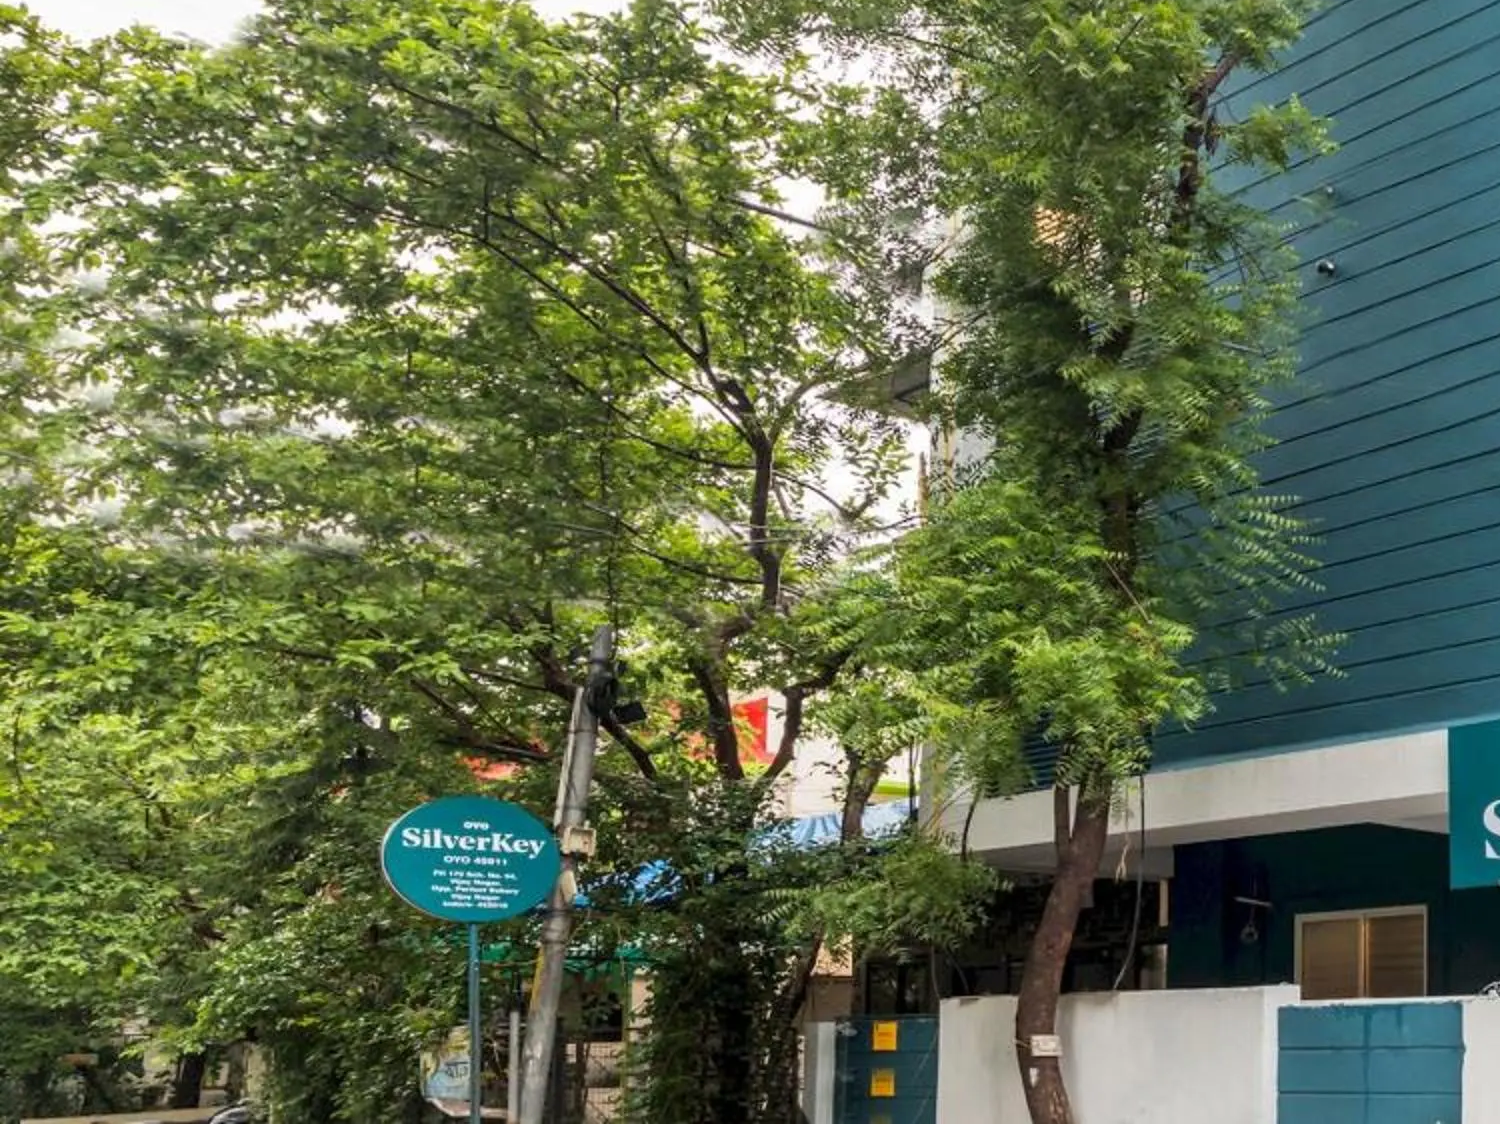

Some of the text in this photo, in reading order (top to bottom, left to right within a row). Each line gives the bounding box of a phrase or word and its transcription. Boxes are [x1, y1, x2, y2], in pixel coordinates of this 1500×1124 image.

[463, 821, 489, 831] OYO
[401, 827, 546, 859] SilverKey
[443, 855, 471, 865] OYO
